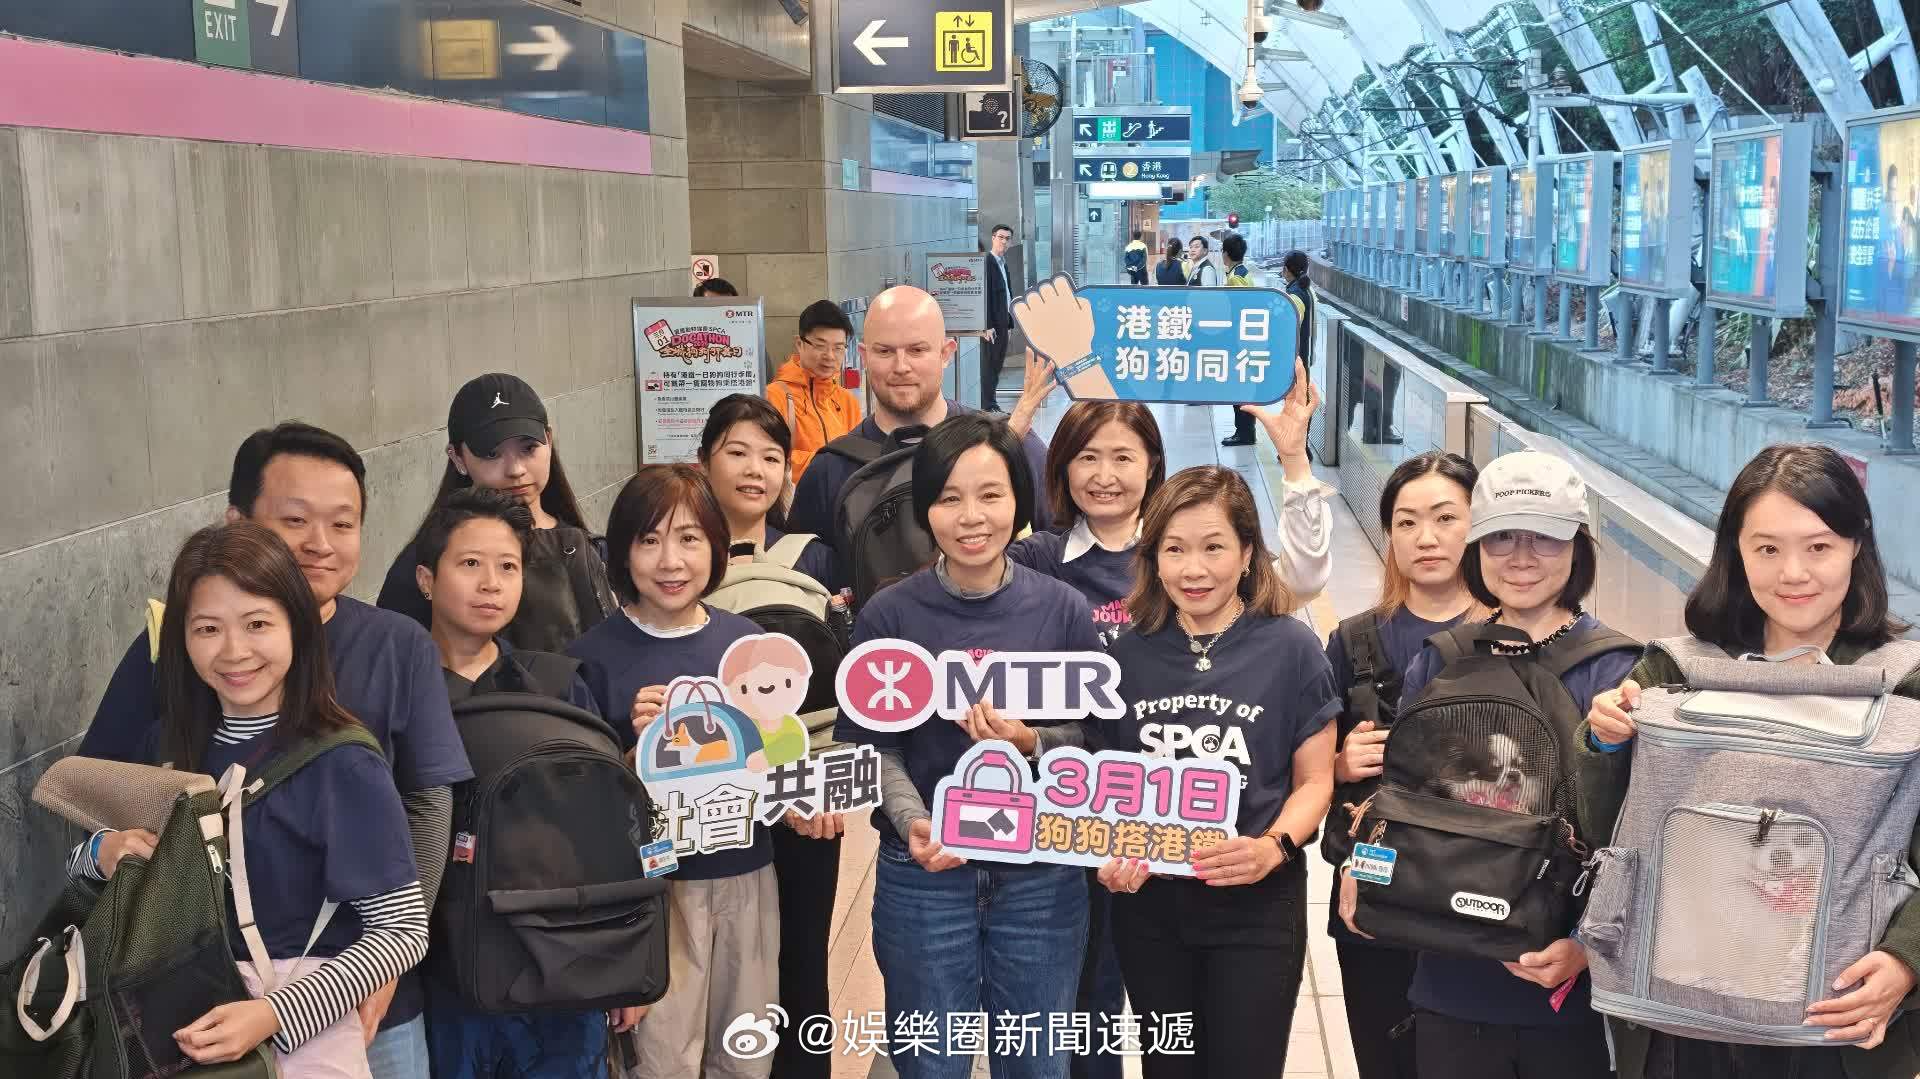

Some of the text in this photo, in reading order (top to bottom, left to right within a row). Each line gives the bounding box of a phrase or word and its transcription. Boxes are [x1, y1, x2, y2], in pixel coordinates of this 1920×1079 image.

[204, 10, 237, 41] EXIT
[1102, 120, 1117, 132] 出
[1142, 161, 1162, 172] 香港
[1116, 305, 1270, 341] 港鐵一日
[1115, 347, 1271, 383] 狗狗同行
[946, 661, 1117, 710] MTR
[1134, 693, 1264, 722] Property of
[1139, 722, 1252, 766] SPCA
[1044, 756, 1231, 824] 3月1日
[1455, 897, 1505, 915] OUTDOOR
